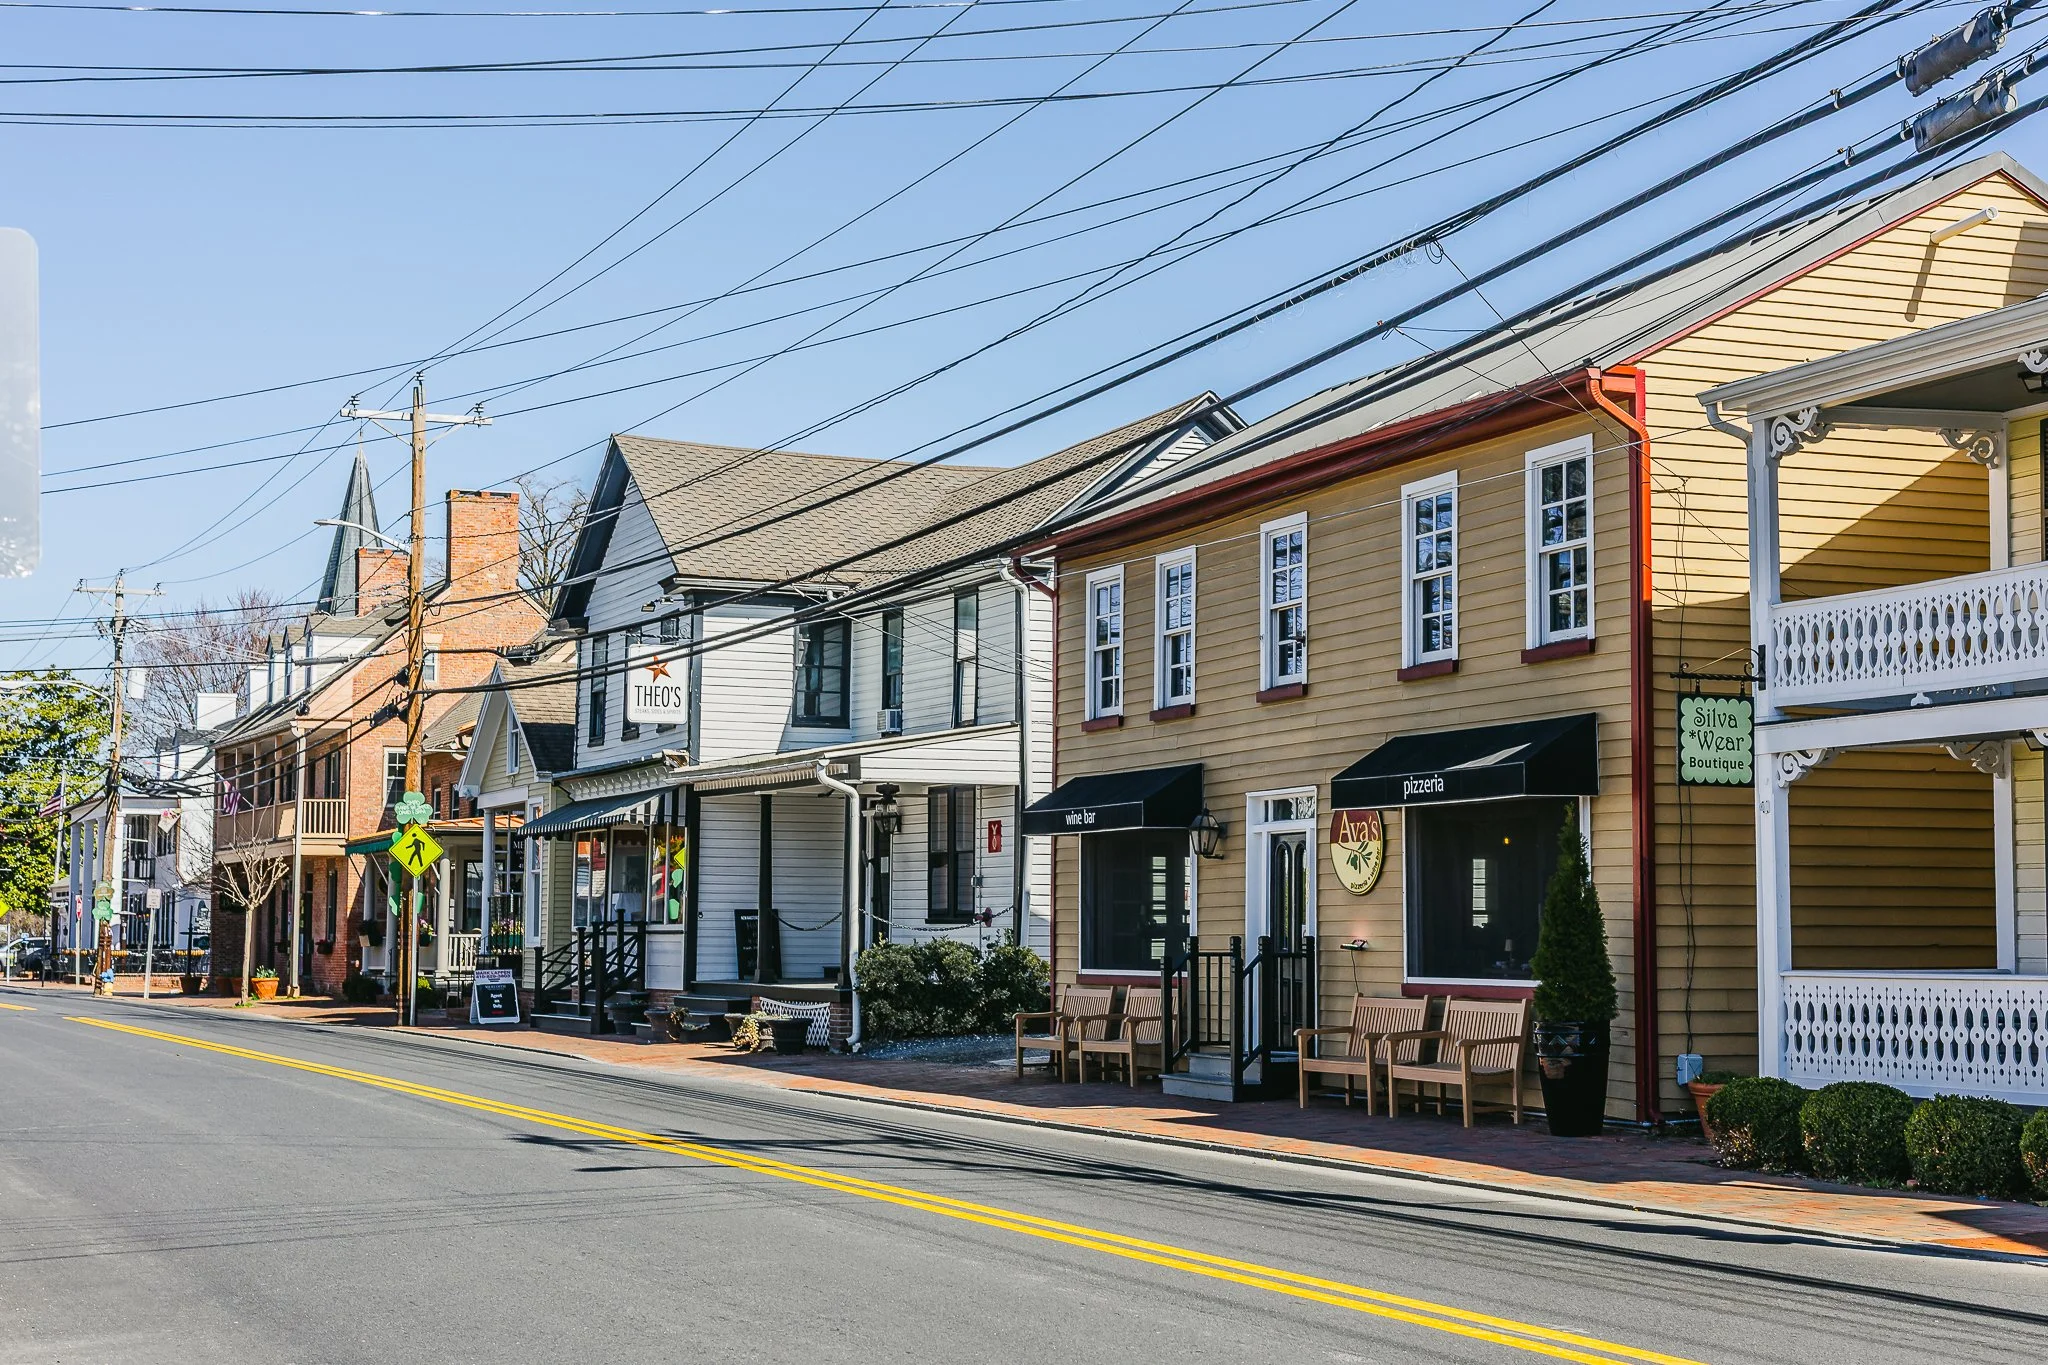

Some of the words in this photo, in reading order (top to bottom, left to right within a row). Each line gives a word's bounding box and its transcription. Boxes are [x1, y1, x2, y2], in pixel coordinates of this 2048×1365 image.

[634, 685, 681, 707] THEO'S
[1694, 707, 1738, 728] Silva
[1689, 756, 1745, 772] Boutique
[1403, 773, 1444, 800] pizzeria
[1065, 810, 1082, 825] wine
[1083, 808, 1096, 824] bar
[1338, 811, 1379, 843] Ava's
